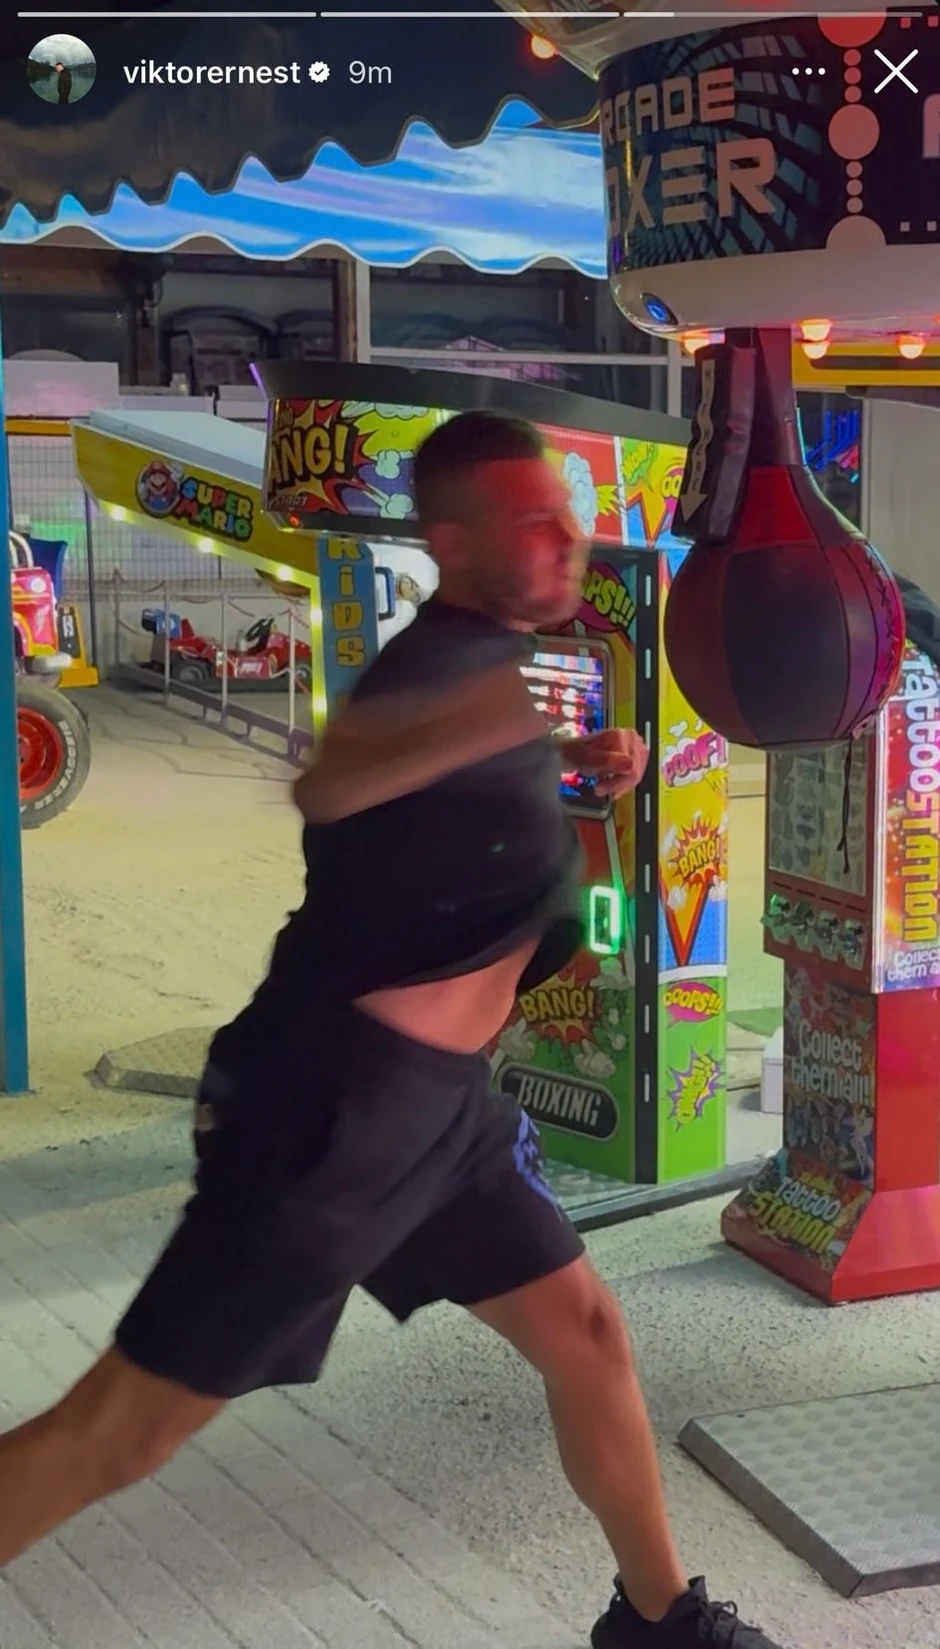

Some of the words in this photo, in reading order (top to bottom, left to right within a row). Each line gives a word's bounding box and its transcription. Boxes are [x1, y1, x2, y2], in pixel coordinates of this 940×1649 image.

[601, 67, 735, 147] RCADE
[181, 478, 252, 518] SUPER
[582, 569, 635, 627] PS!!!
[662, 731, 727, 787] POOF!
[678, 837, 721, 877] BANG!
[518, 985, 595, 1022] BANG!
[800, 1019, 862, 1072] Collect
[517, 1074, 601, 1127] BOXING
[775, 1176, 841, 1222] Tattoo
